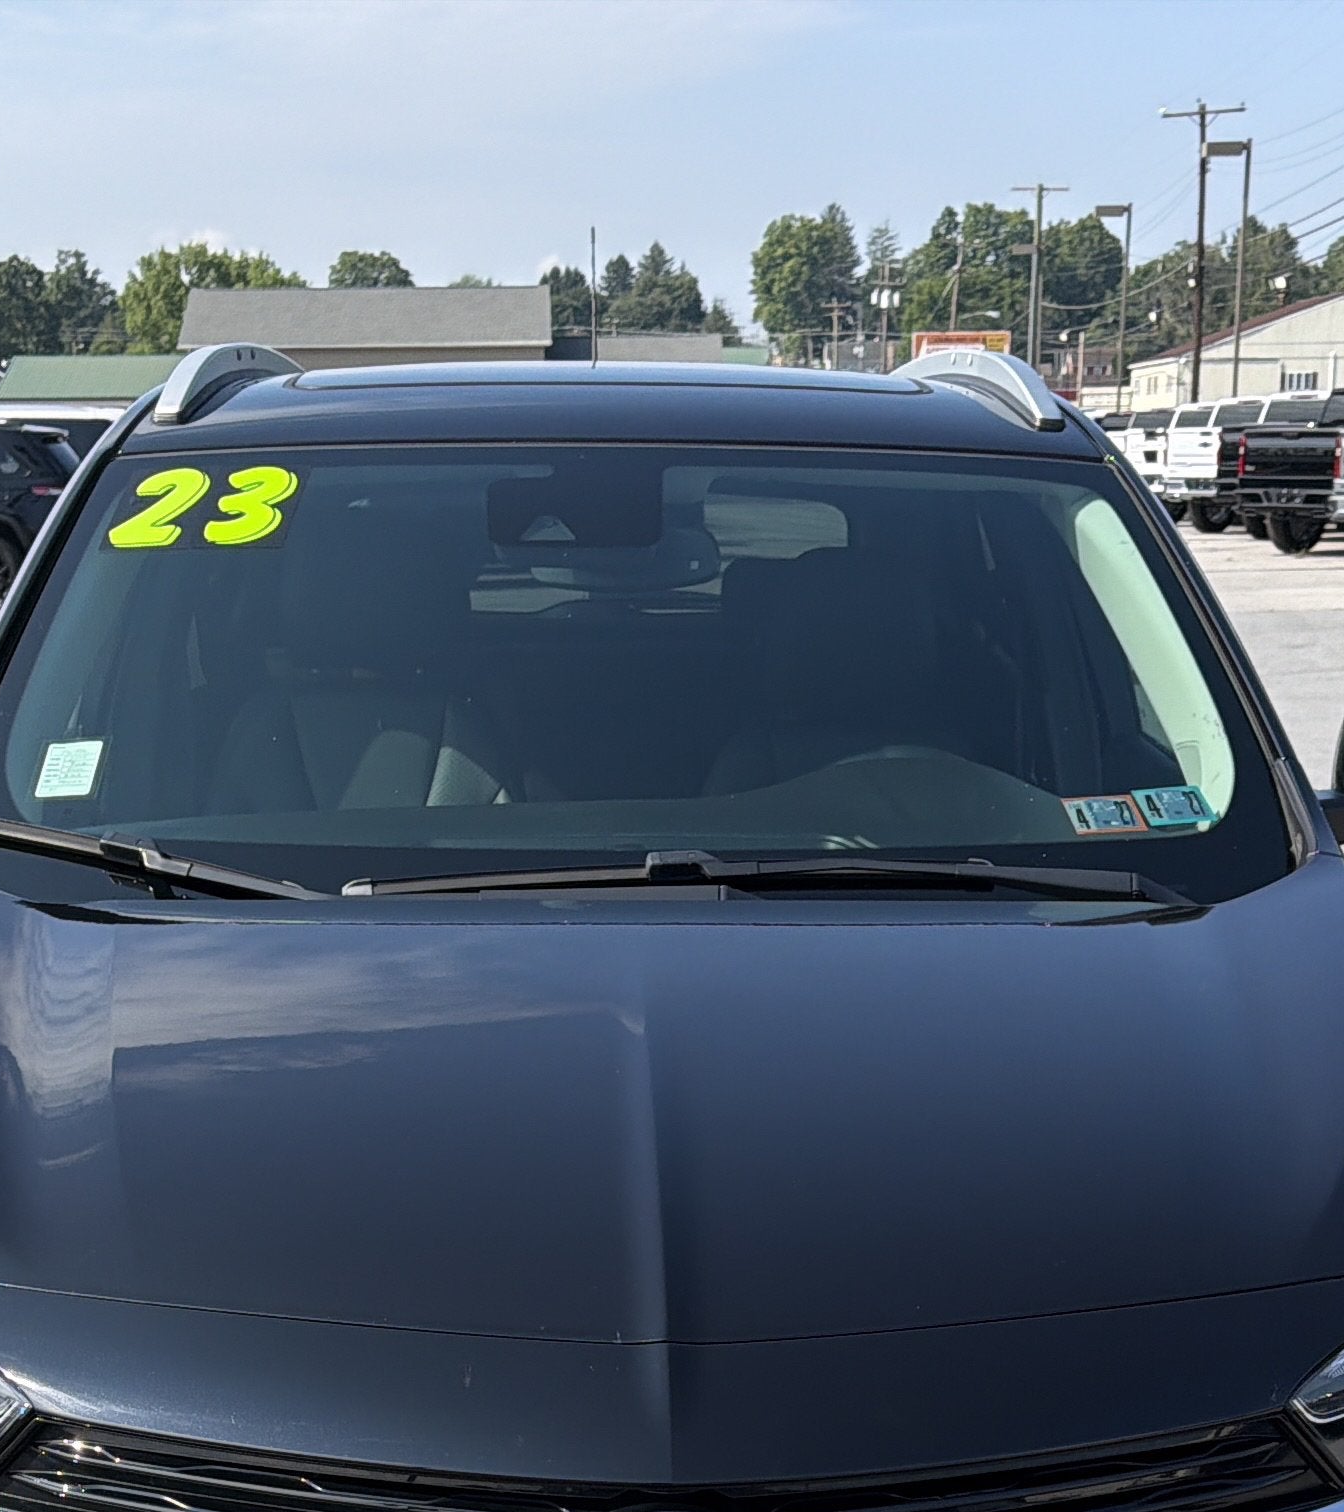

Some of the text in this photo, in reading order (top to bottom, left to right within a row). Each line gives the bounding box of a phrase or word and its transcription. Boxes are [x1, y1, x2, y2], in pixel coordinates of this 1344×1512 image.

[108, 465, 299, 548] 23
[1075, 801, 1137, 830] 4 27
[1145, 790, 1206, 819] 4 27
